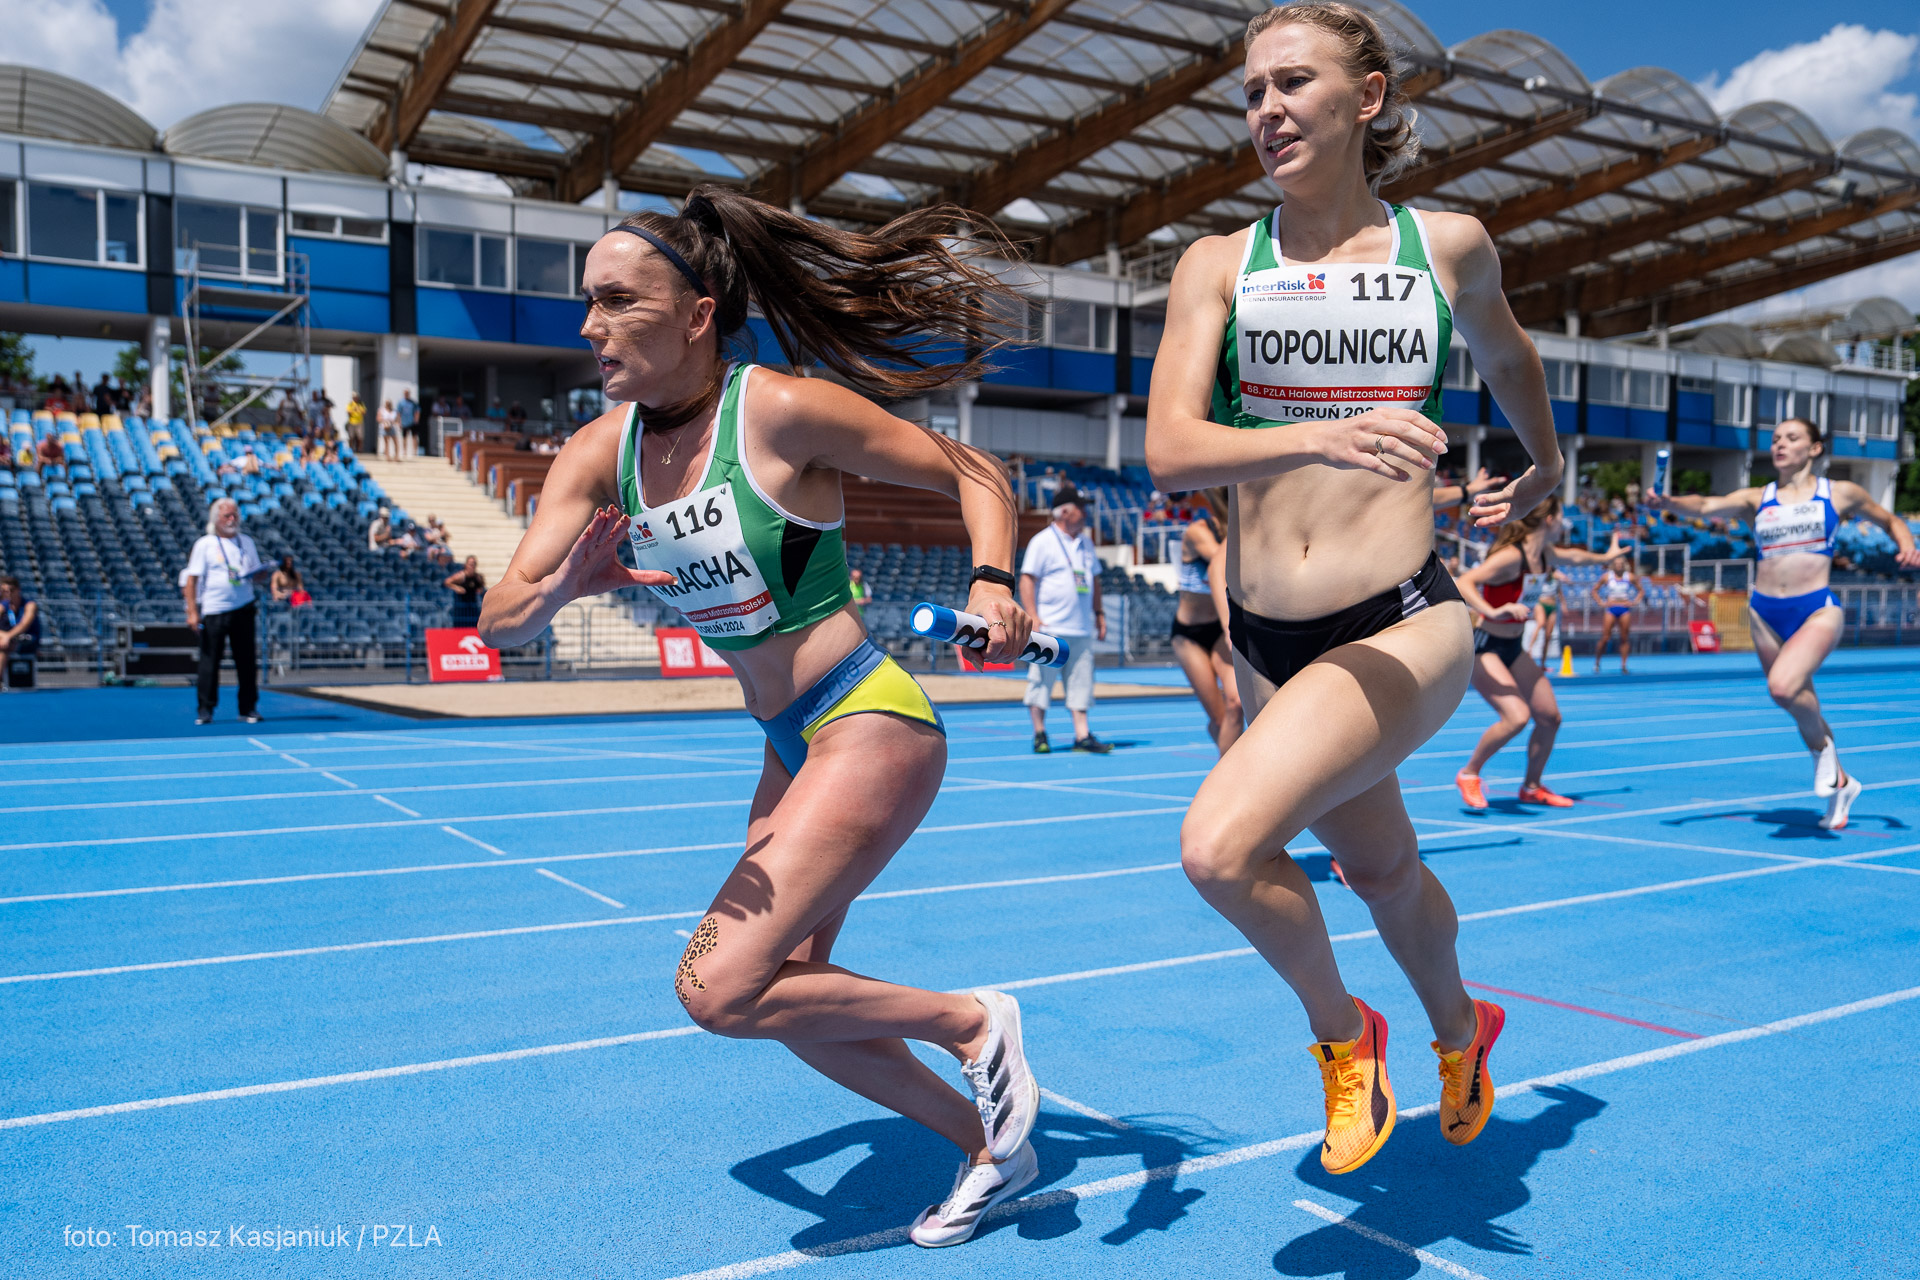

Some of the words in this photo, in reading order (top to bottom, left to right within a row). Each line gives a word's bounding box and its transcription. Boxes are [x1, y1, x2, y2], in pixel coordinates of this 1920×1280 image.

[1242, 279, 1306, 294] InterRisk
[1350, 272, 1417, 302] 117
[1245, 328, 1429, 365] TOPOLNICKA
[1247, 384, 1262, 395] 68.
[1263, 387, 1286, 398] PZLA
[1288, 389, 1328, 399] Halowe
[1330, 389, 1394, 399] Mistrzostwa
[1396, 388, 1426, 398] Polski
[1281, 403, 1340, 419] TORUŃ
[665, 496, 723, 541] 116
[740, 595, 766, 613] Polski
[695, 621, 725, 634] TORUŃ
[723, 620, 746, 632] 2024
[787, 692, 825, 731] NIKE
[824, 660, 860, 700] PRO
